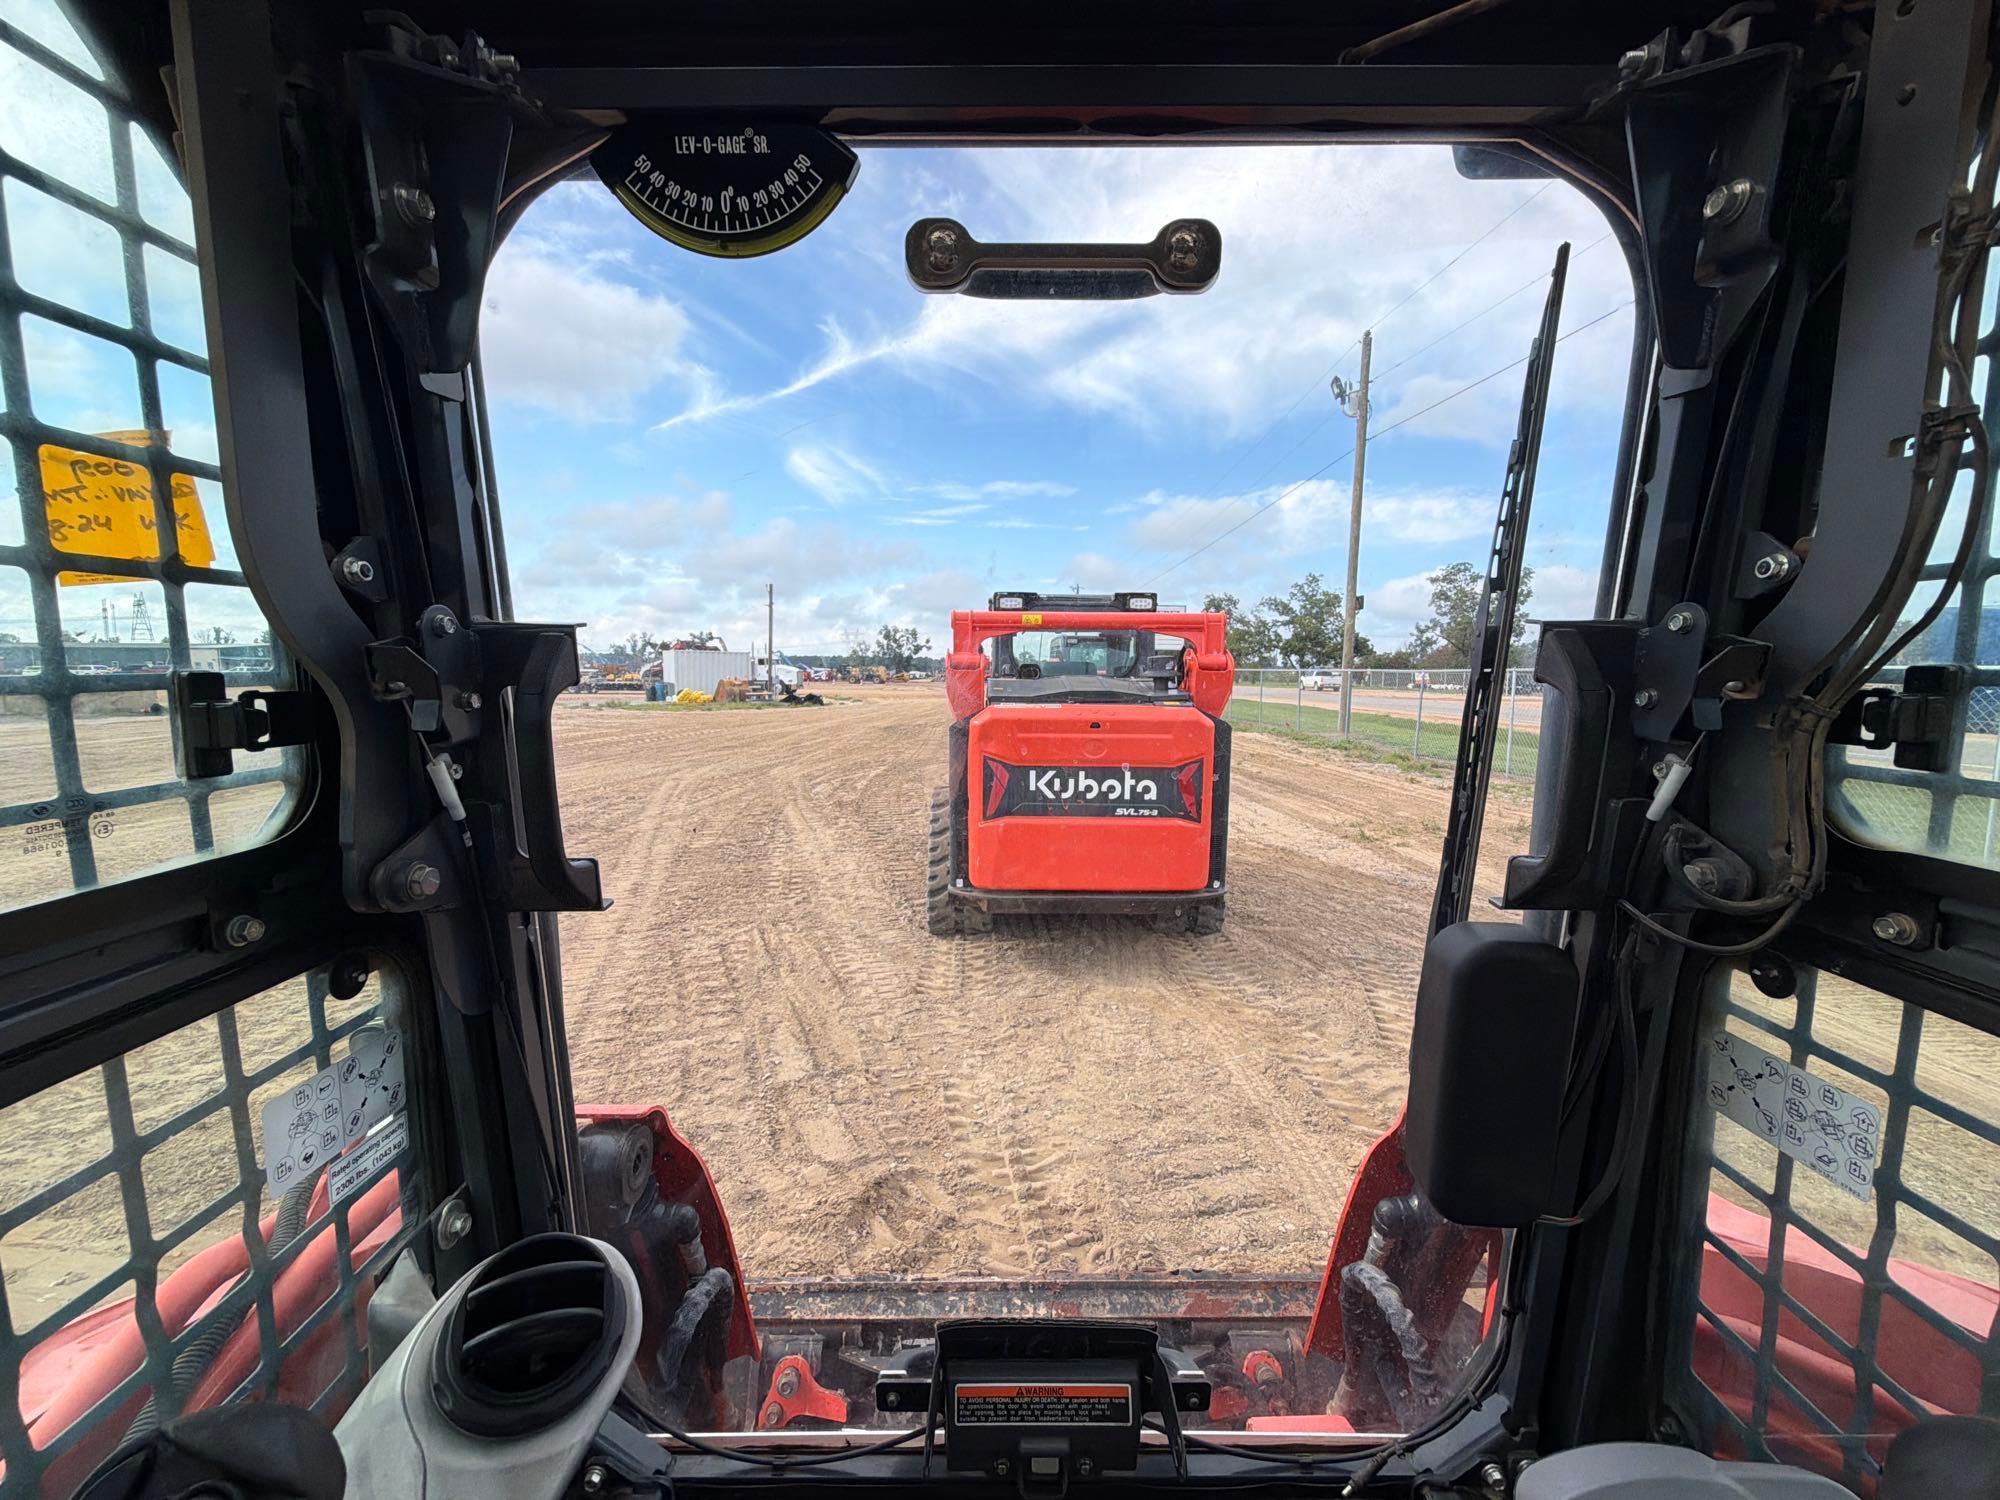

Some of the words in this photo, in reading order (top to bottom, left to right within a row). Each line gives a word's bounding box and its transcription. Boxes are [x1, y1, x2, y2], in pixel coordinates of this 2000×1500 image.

[753, 137, 771, 154] SR.
[634, 154, 651, 174] 50
[650, 170, 665, 188] 40
[665, 181, 681, 199] 30
[682, 191, 697, 208] 20
[701, 196, 713, 212] 10
[736, 196, 749, 212] 10
[753, 190, 769, 208] 20
[768, 180, 785, 200] 30
[783, 168, 799, 187] 40
[794, 153, 811, 174] 50
[1029, 770, 1157, 800] Kubota
[331, 1161, 351, 1180] Rated
[352, 1140, 381, 1170] operating
[381, 1122, 405, 1146] capacity
[335, 1175, 355, 1197] 2300
[355, 1165, 370, 1180] lbs.
[372, 1146, 392, 1168] (1043
[393, 1137, 405, 1152] kg)
[1025, 1387, 1064, 1396] WARNING
